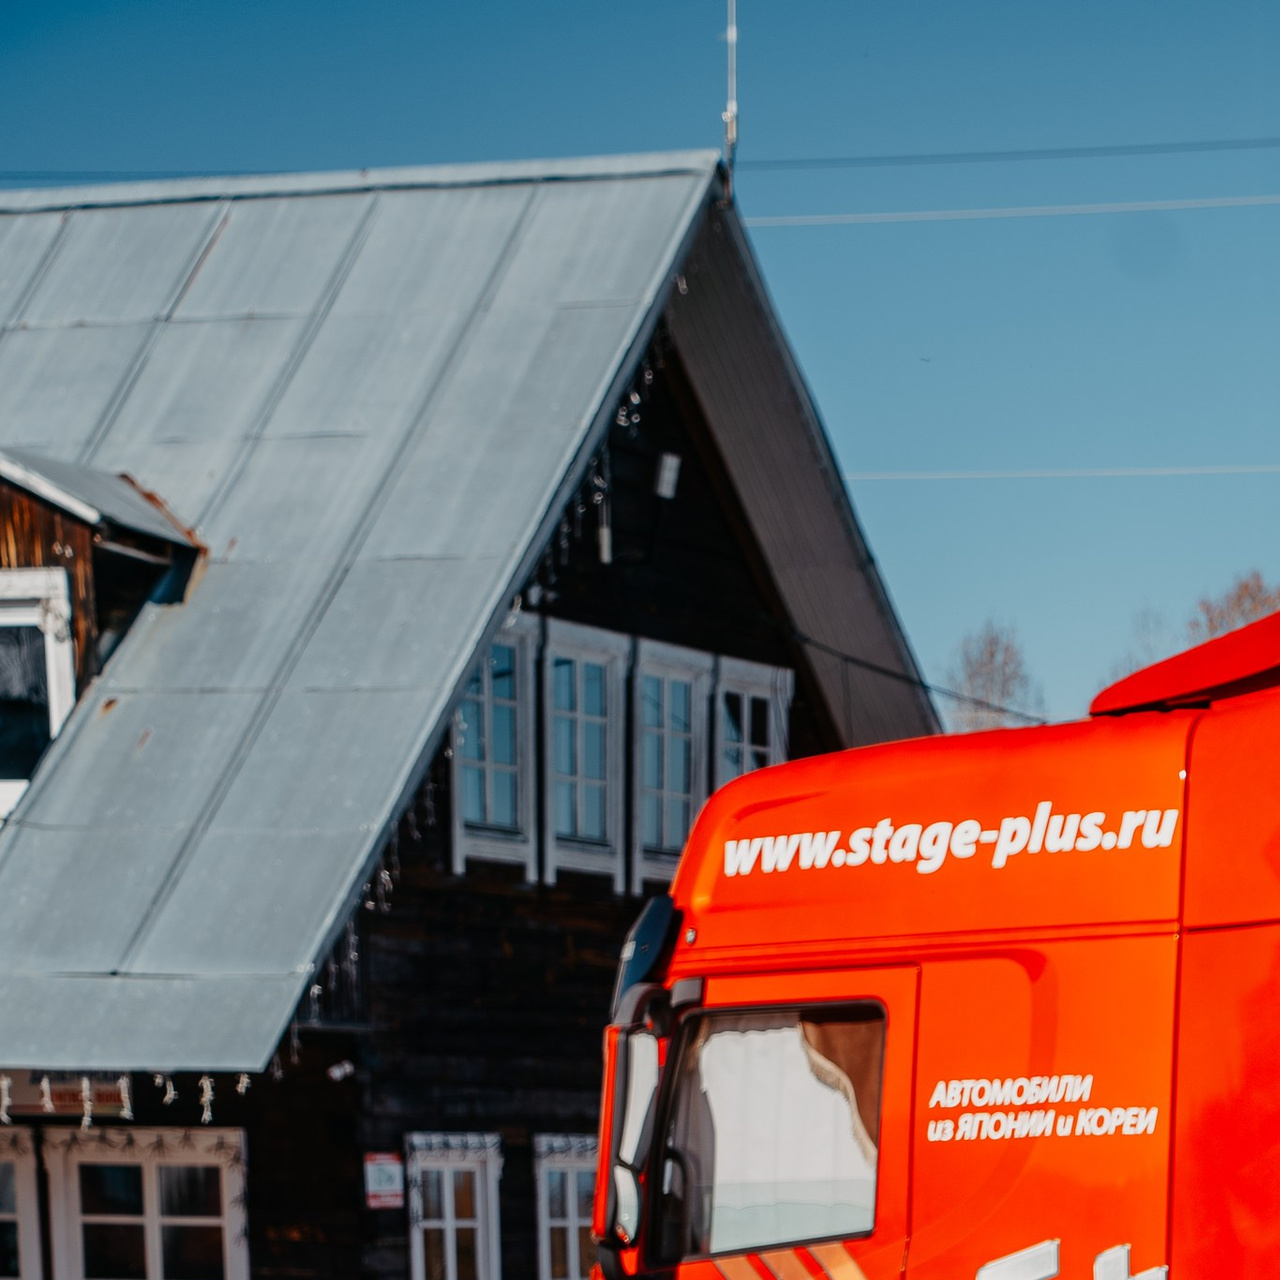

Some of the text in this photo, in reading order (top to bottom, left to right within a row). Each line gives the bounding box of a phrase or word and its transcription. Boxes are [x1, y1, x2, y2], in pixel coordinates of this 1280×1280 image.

[724, 801, 1179, 876] www.stage-plus.ru
[929, 1074, 1093, 1108] АВТОМОБИЛИ
[927, 1120, 954, 1142] из
[956, 1109, 1056, 1141] ЯПОНИИ
[1075, 1106, 1158, 1136] КОРЕИ
